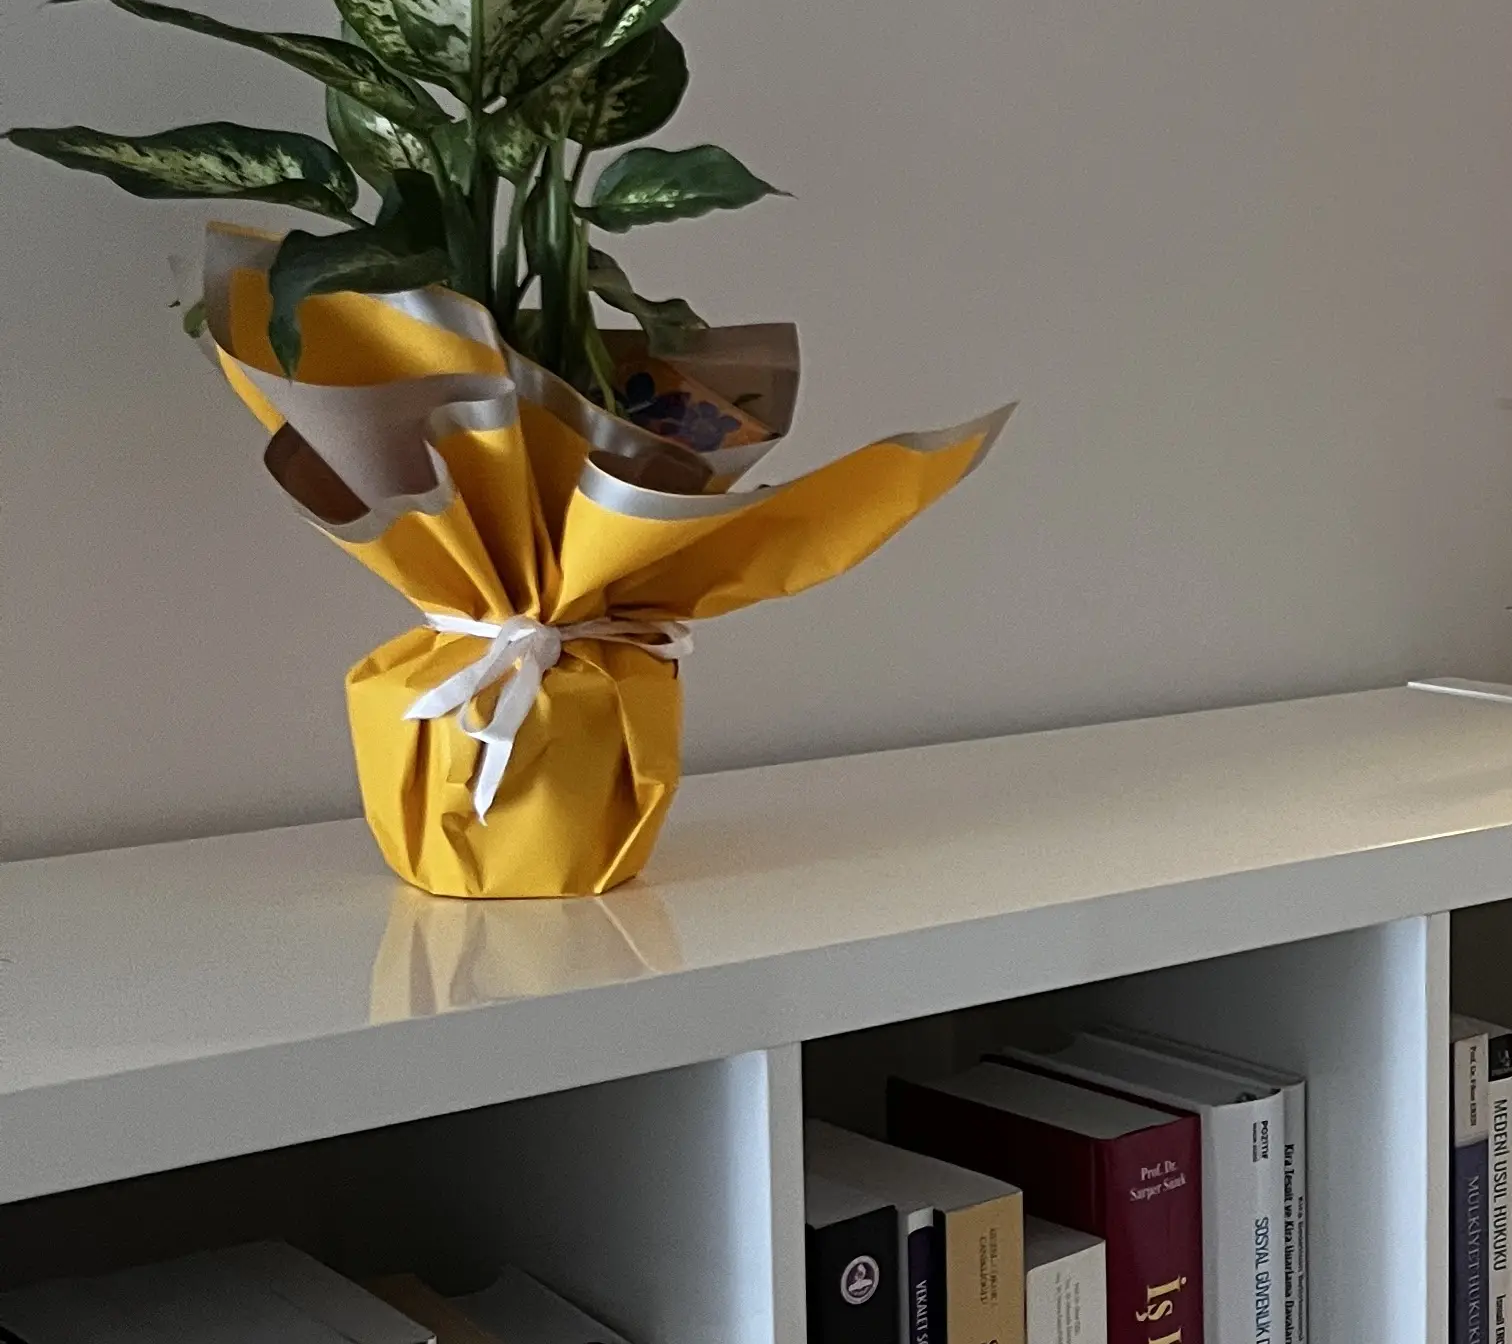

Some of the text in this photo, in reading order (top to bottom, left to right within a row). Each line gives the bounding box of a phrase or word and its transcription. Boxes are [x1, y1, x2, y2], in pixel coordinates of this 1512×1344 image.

[1284, 1144, 1295, 1167] Kira
[1493, 1099, 1509, 1272] MEDENİ USUL HUKUKU
[1255, 1216, 1270, 1270] SOSYAL
[1136, 1275, 1186, 1322] İş
